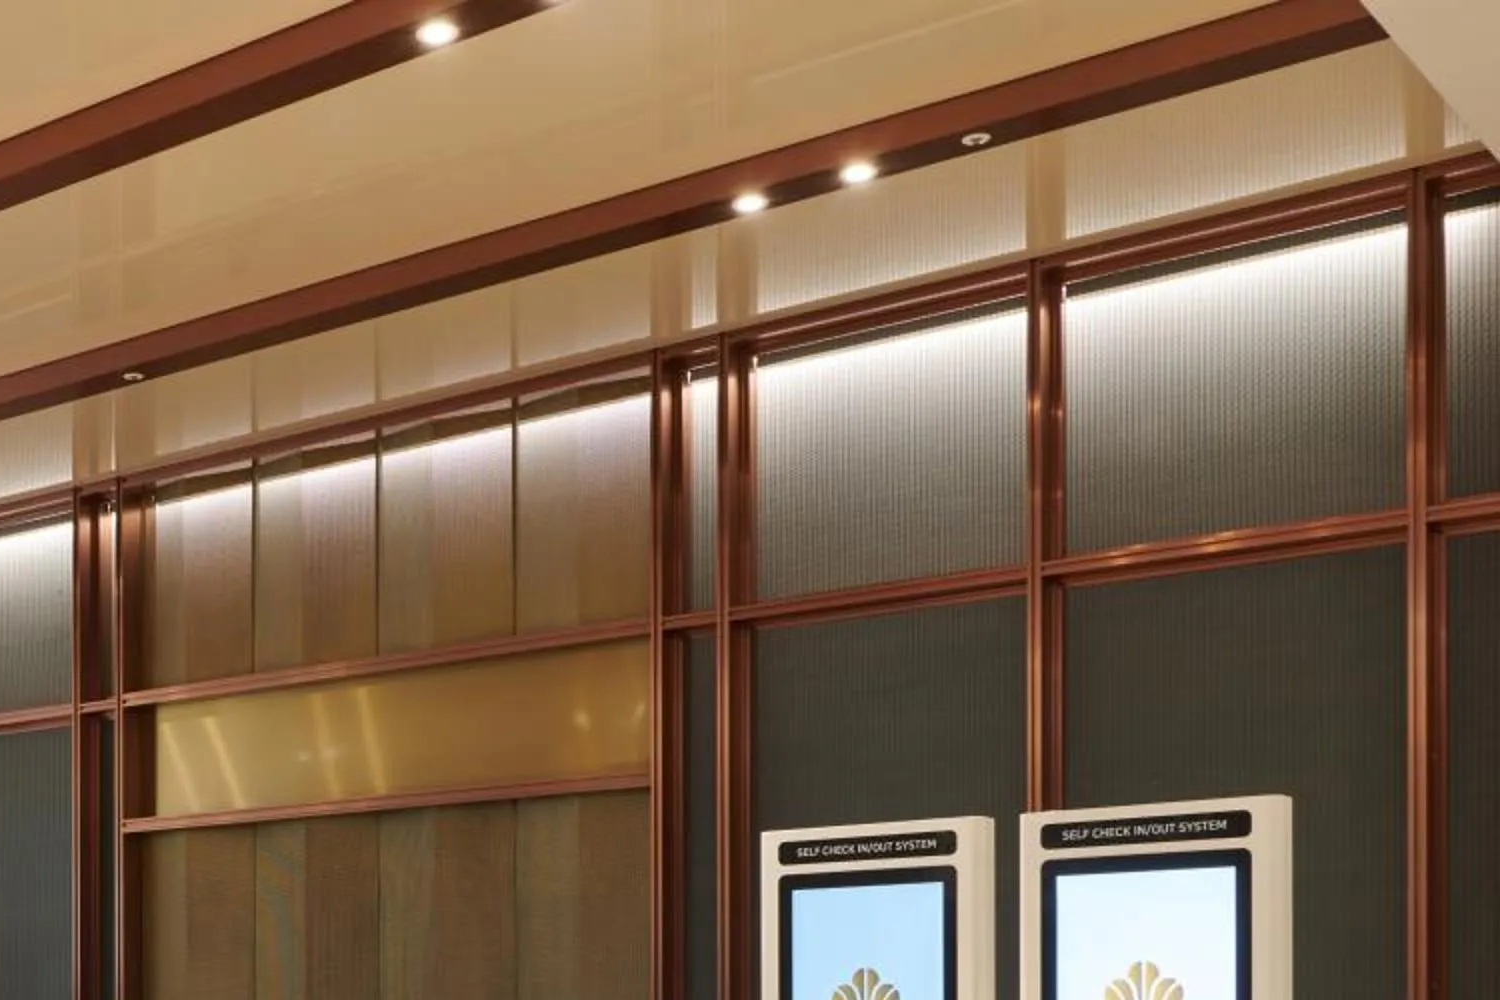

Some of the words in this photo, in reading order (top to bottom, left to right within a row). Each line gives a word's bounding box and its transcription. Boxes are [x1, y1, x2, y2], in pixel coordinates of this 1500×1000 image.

[1061, 828, 1090, 841] SELF
[1092, 826, 1131, 839] CHECK
[1133, 822, 1176, 837] IN/OUT
[1179, 819, 1228, 833] SYSTEM
[797, 847, 821, 858] SELF
[822, 844, 855, 856] CHECK
[857, 842, 893, 855] IN/OUT
[895, 838, 937, 851] SYSTEM
